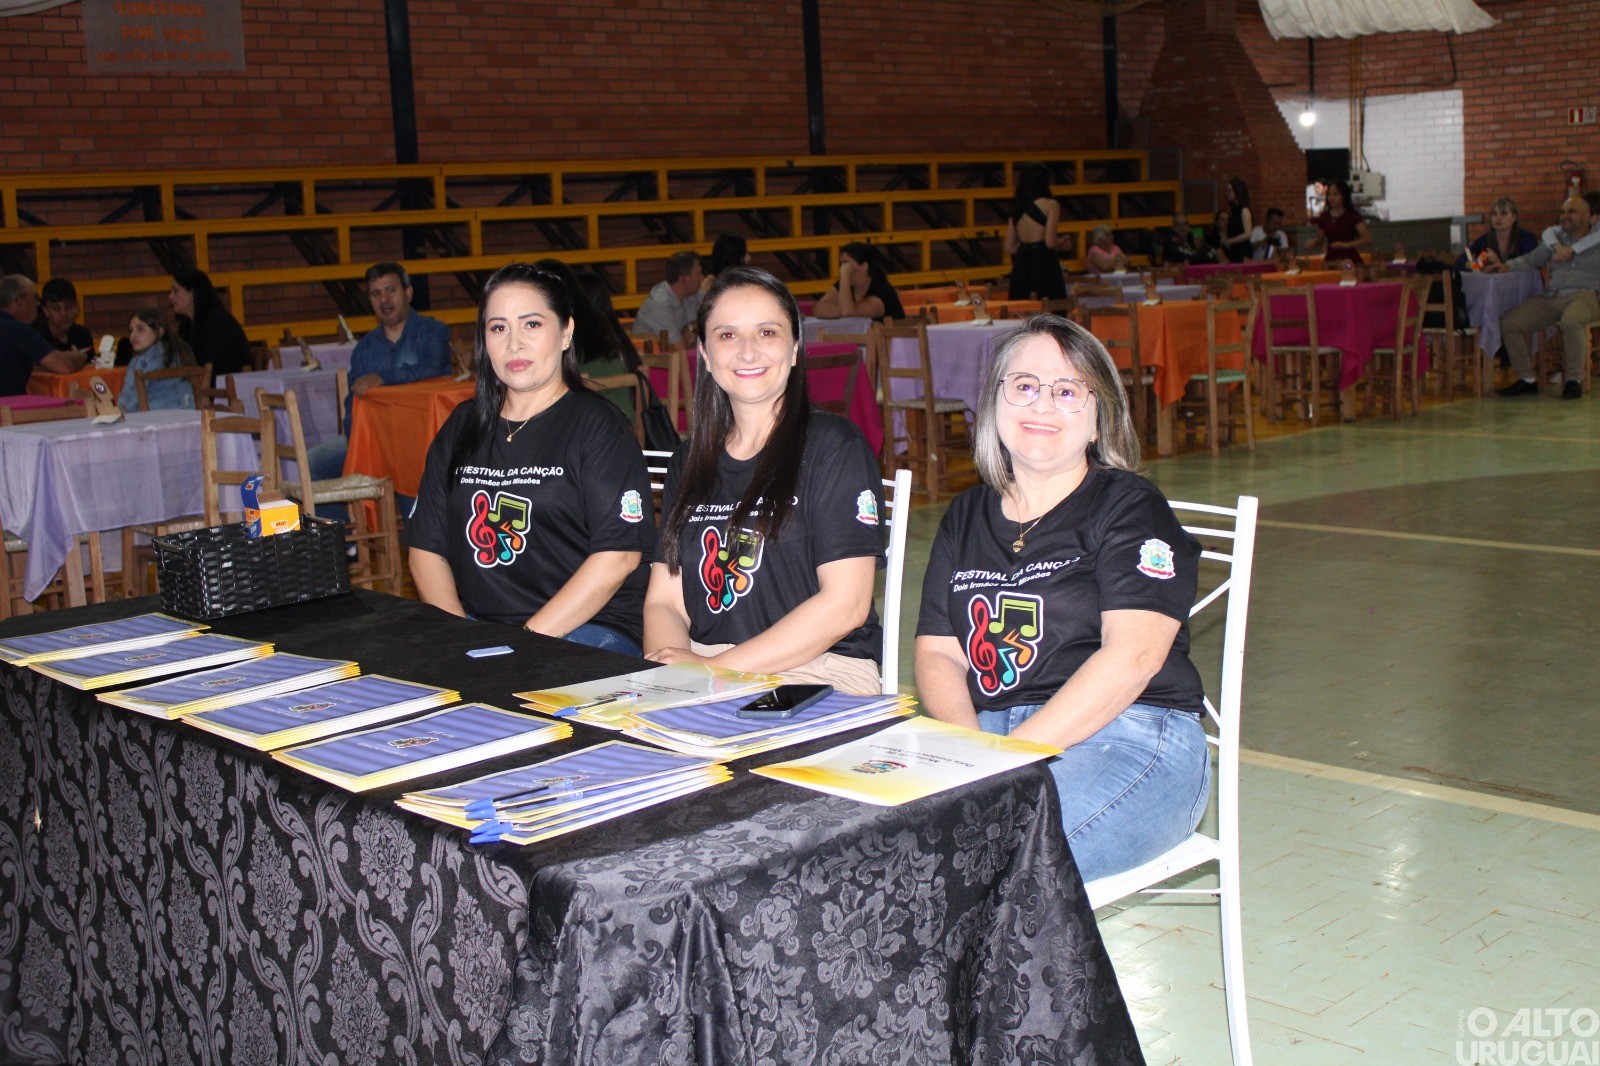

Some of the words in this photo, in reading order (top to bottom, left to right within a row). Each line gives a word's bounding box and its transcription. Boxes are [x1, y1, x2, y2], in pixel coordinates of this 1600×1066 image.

[506, 467, 519, 477] DA
[520, 465, 564, 477] CANÇÃO
[460, 476, 475, 484] Dois
[475, 477, 501, 487] Irmãos
[512, 477, 541, 485] Missões
[693, 503, 735, 513] ESTIVAL
[954, 569, 1009, 581] FESTIVAL
[953, 583, 969, 593] Dois
[1018, 571, 1052, 586] Missões
